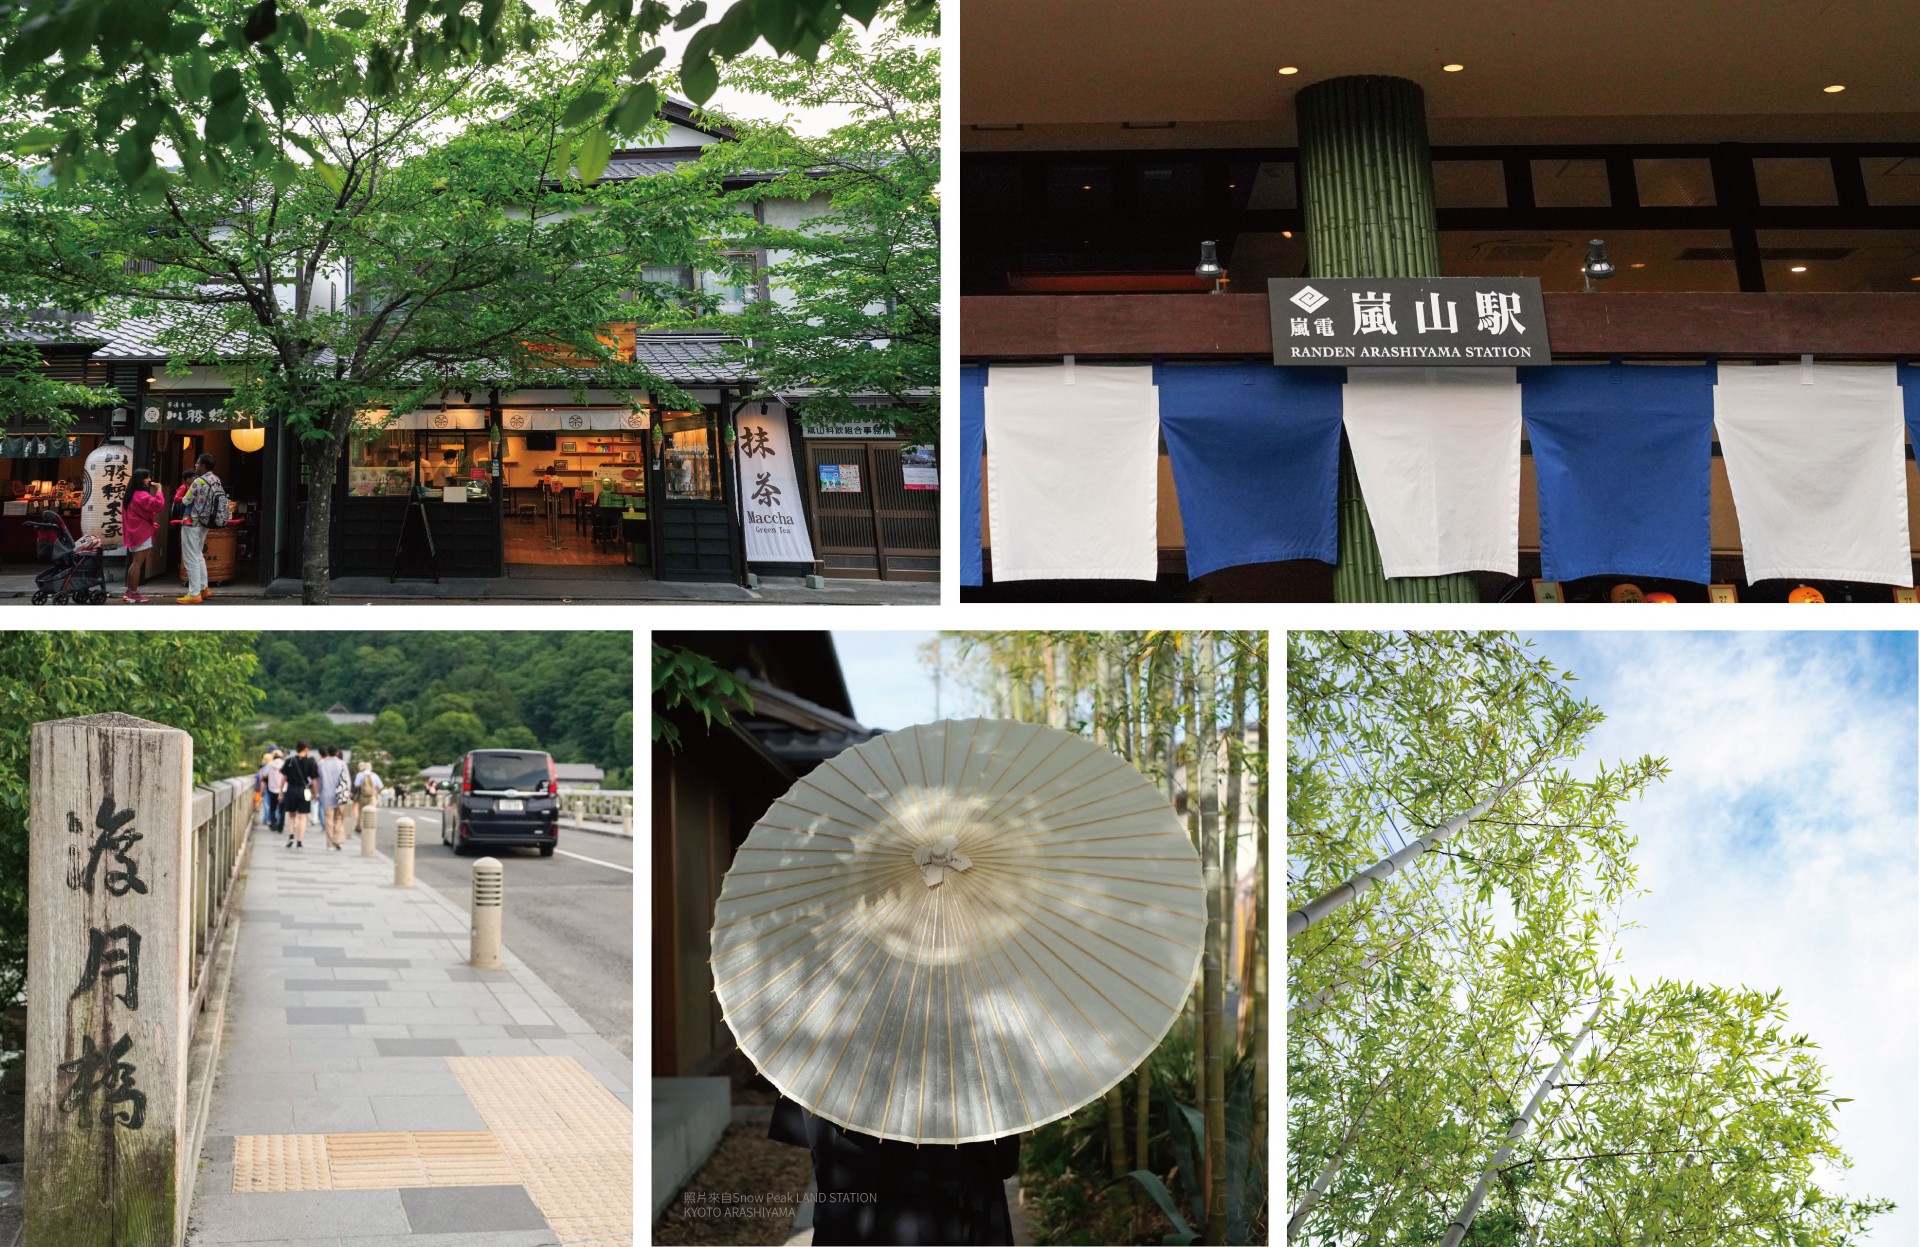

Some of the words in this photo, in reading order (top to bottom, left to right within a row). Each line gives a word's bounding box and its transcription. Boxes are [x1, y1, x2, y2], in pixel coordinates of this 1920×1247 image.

[1351, 291, 1526, 336] 嵐山駅
[1290, 317, 1335, 337] 嵐電
[1291, 347, 1355, 358] RANDEN
[1360, 347, 1462, 358] ARASHIYAMA
[1465, 347, 1532, 358] STATION
[740, 426, 781, 507] 抹茶
[747, 511, 794, 525] Maccha
[779, 526, 791, 534] Tea
